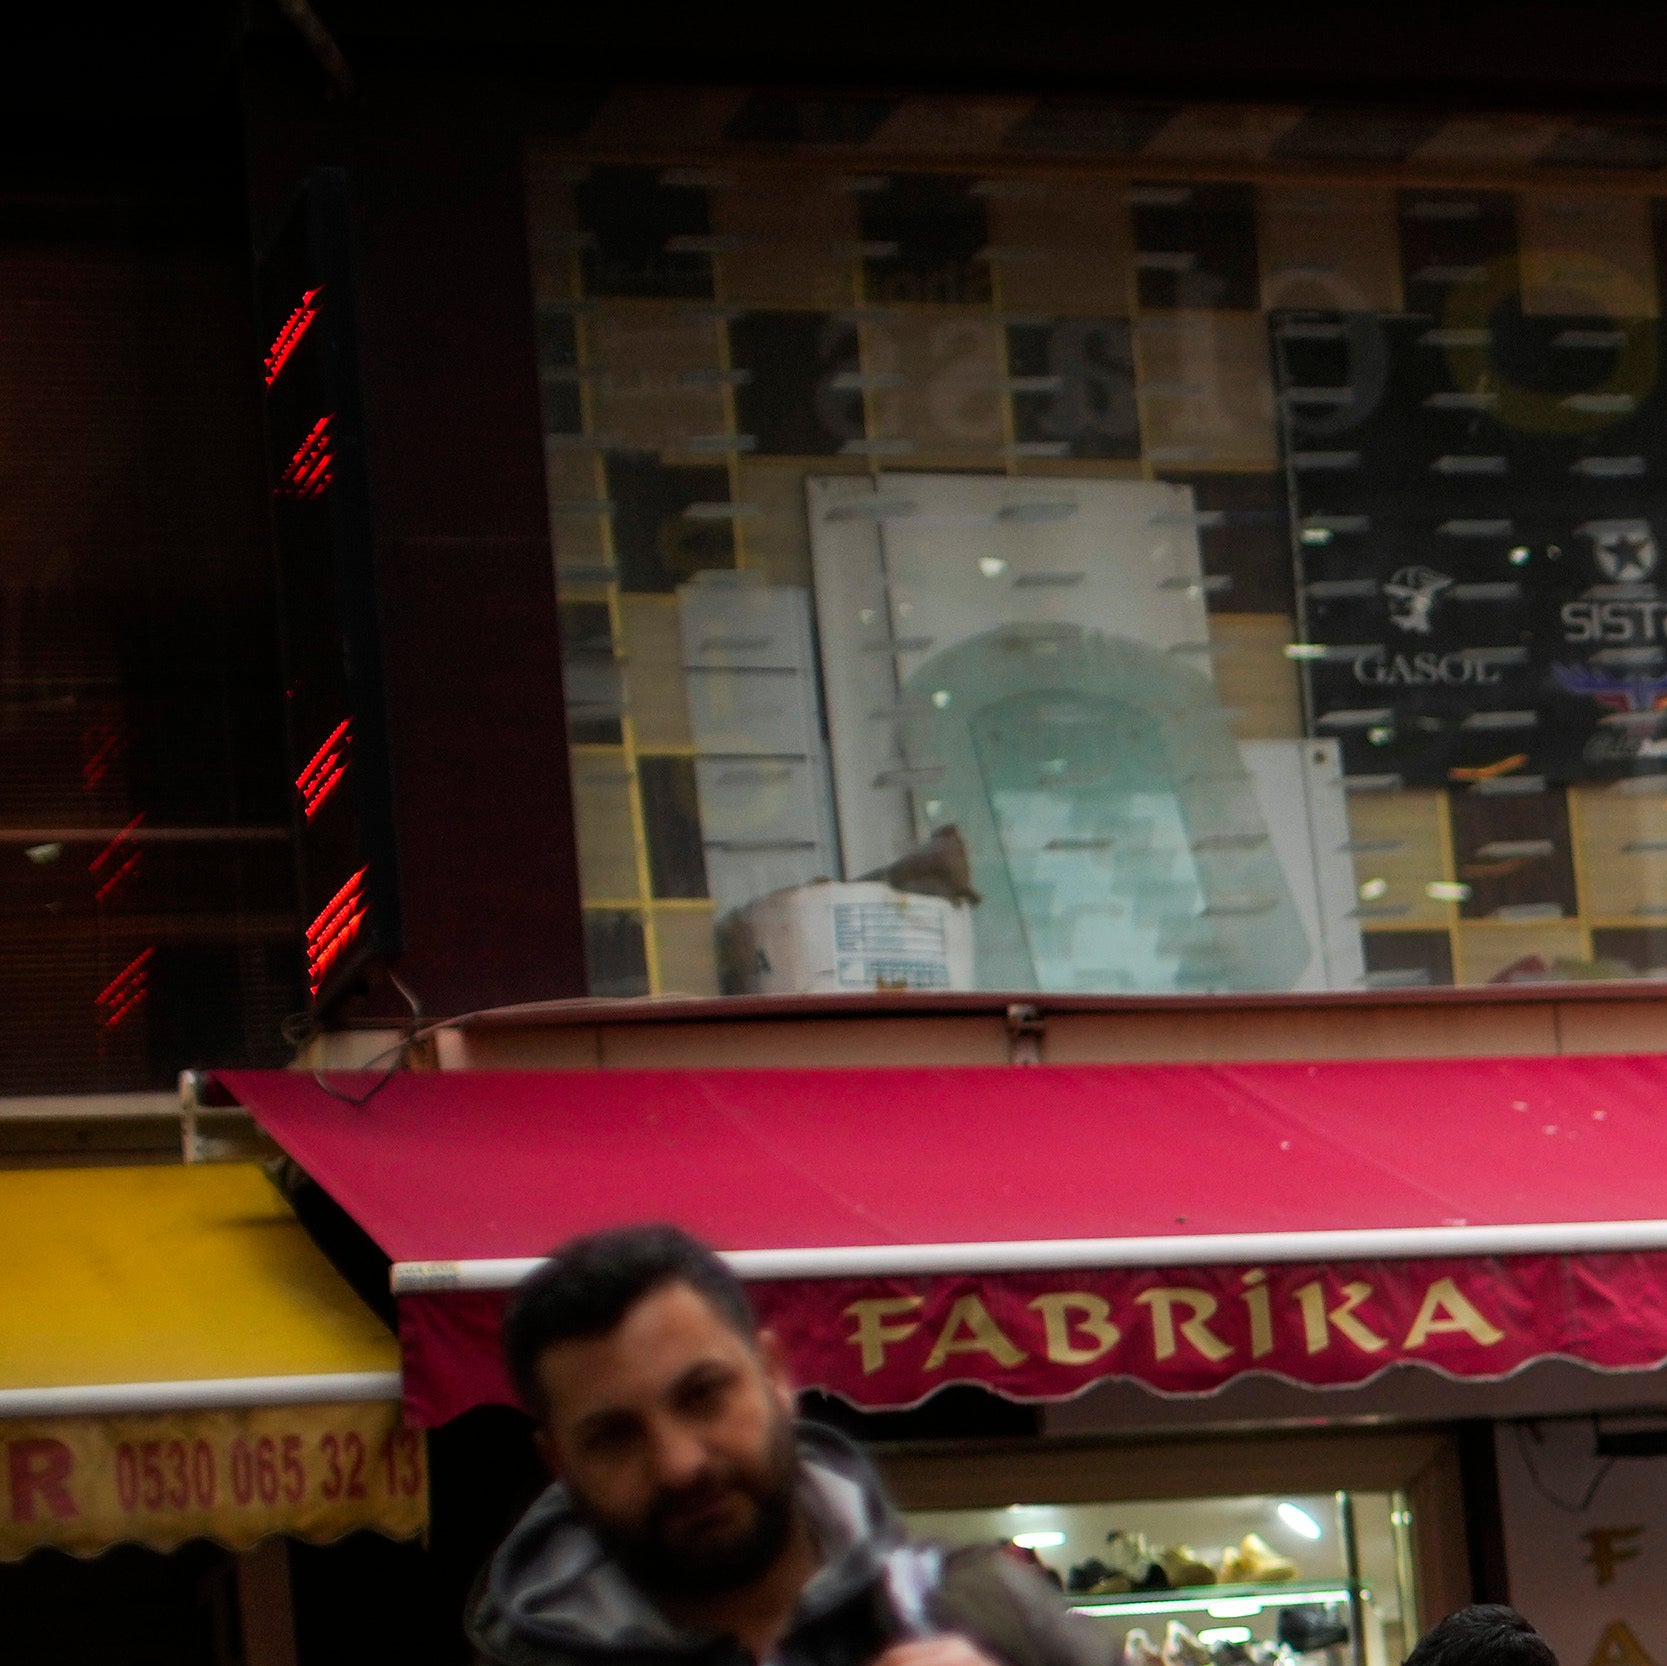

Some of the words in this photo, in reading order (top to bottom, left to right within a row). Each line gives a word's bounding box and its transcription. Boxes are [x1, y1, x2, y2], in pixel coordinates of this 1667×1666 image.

[1352, 651, 1503, 688] GASOL
[842, 1268, 1504, 1376] FABRİKA
[7, 1437, 80, 1523] R
[115, 1438, 217, 1514] 0530
[230, 1433, 306, 1508] 065
[318, 1431, 368, 1502] 32
[378, 1423, 423, 1500] 13
